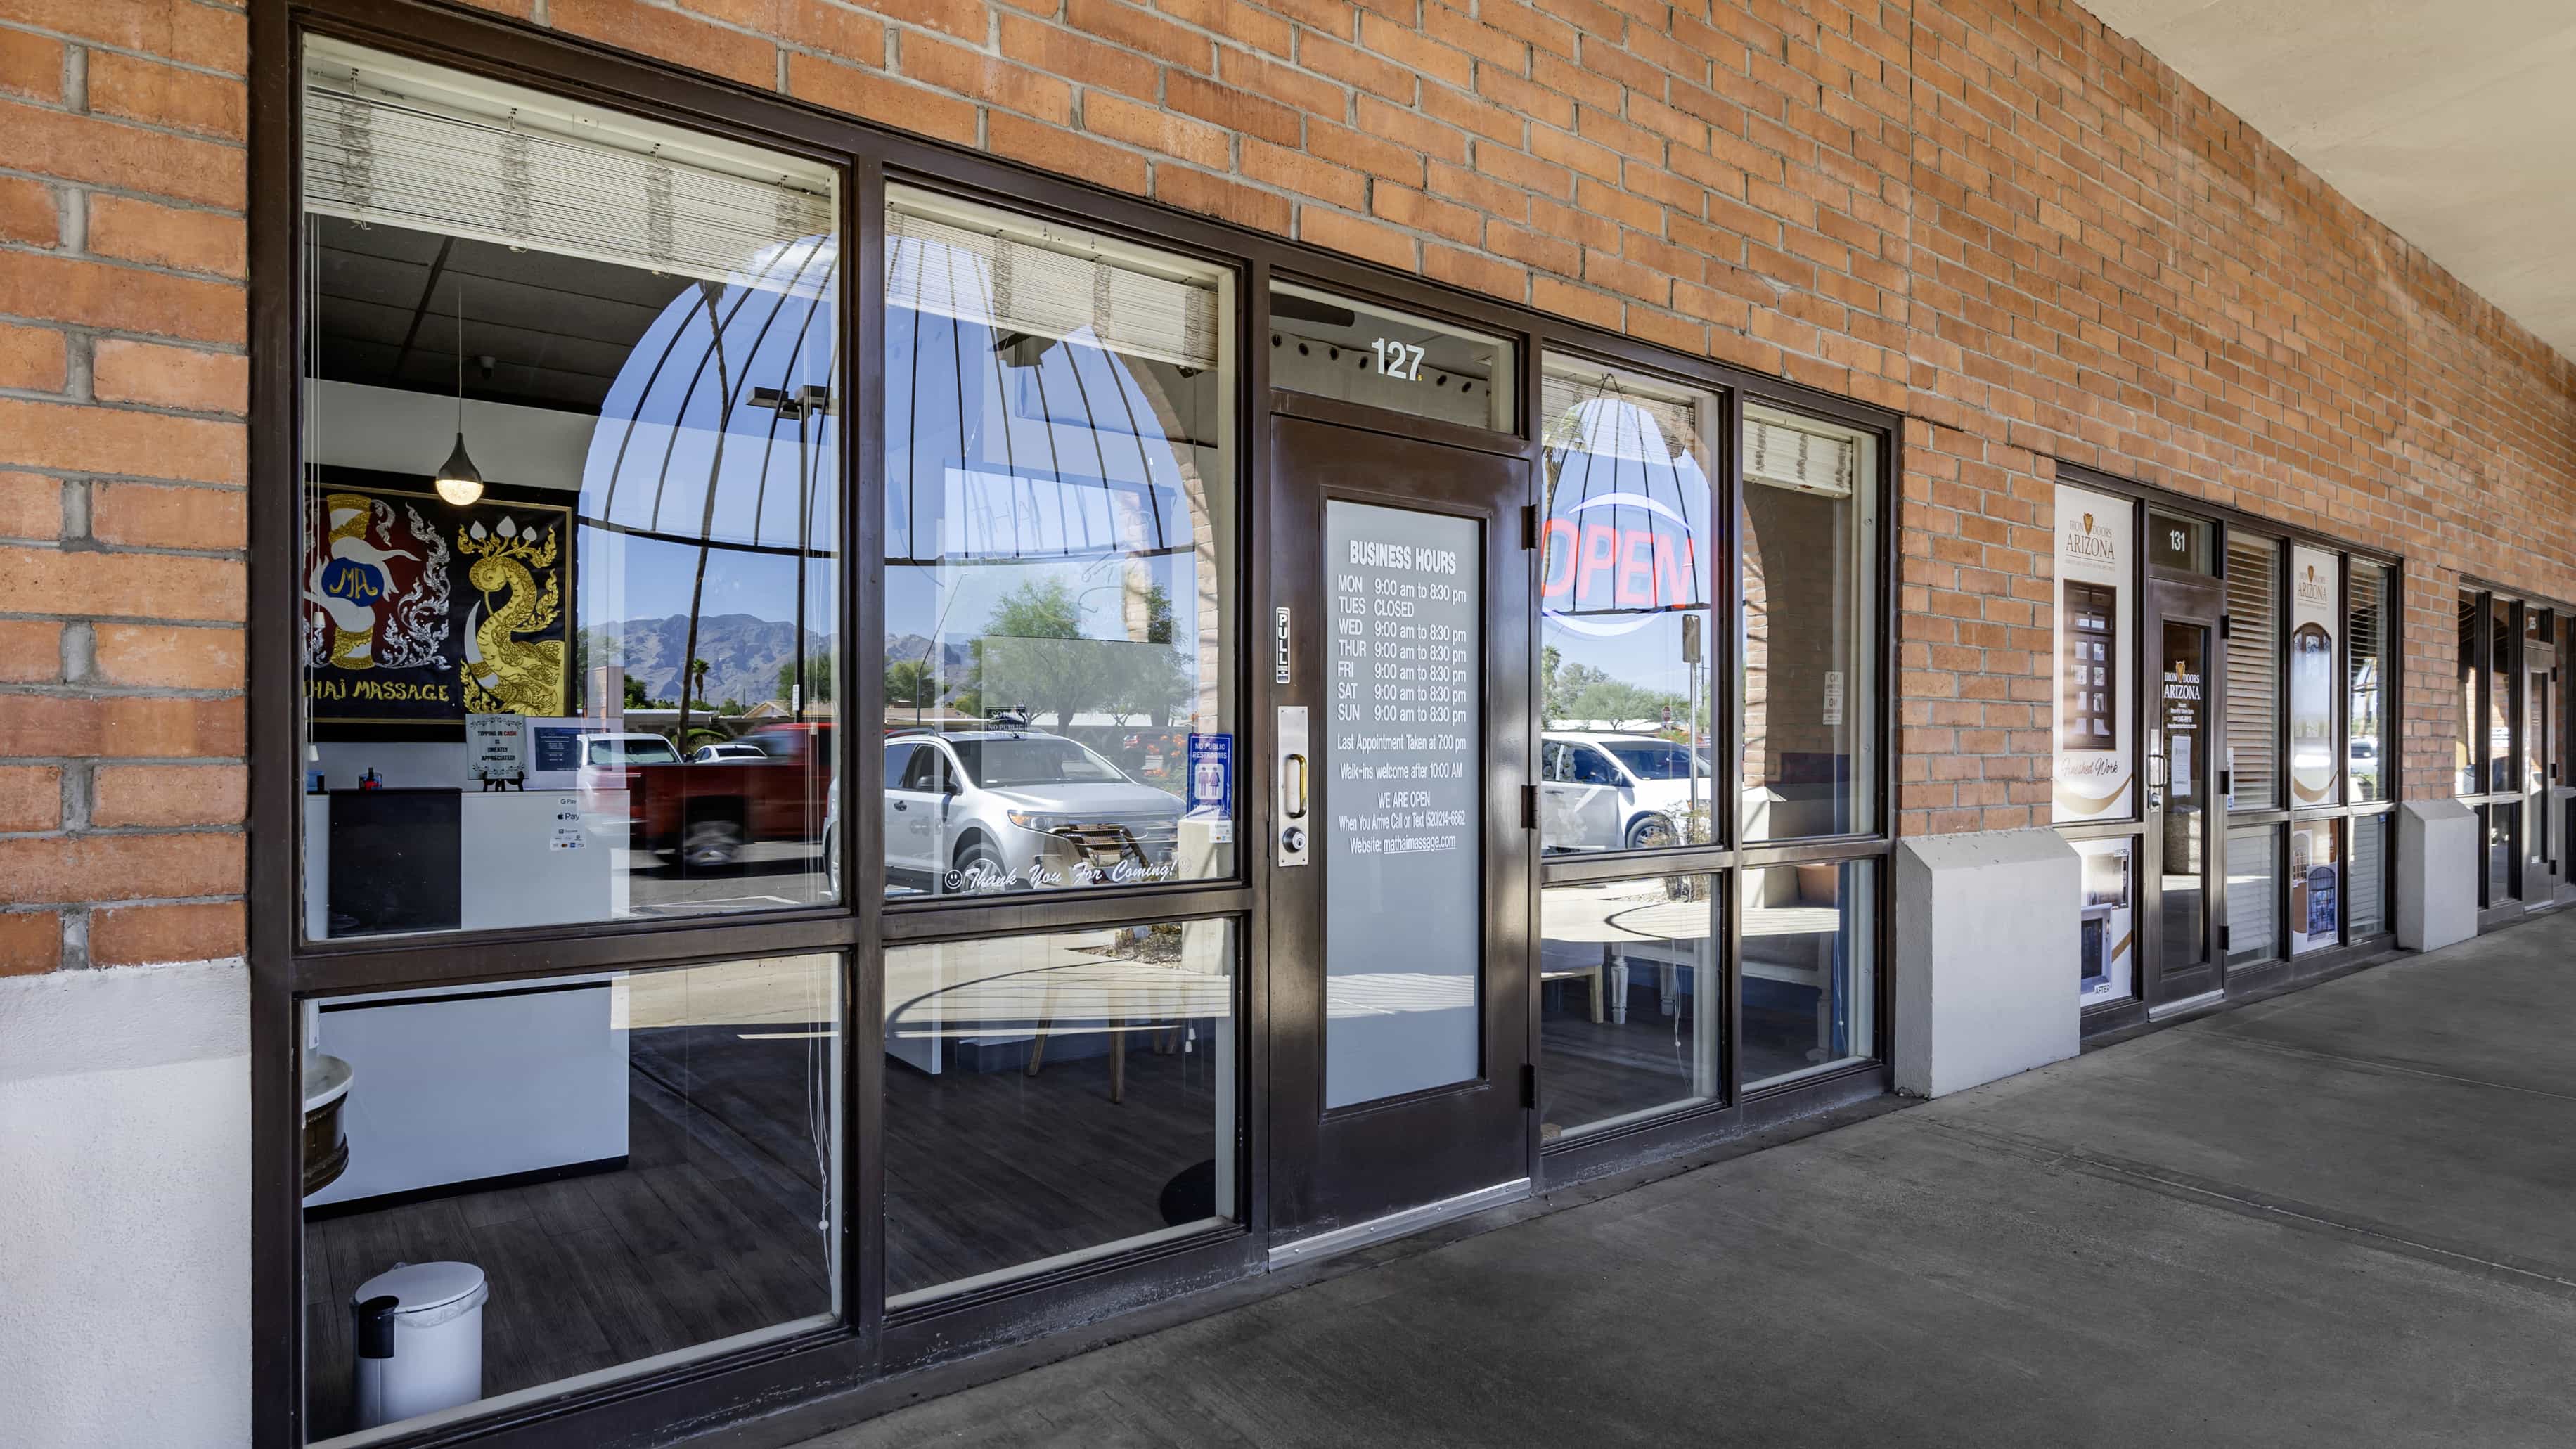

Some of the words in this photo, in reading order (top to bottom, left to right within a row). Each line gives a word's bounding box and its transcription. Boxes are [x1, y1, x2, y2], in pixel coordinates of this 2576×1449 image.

[1372, 337, 1424, 381] 127
[2092, 524, 2112, 539] DOORS
[2170, 529, 2185, 551] 131
[1350, 540, 1412, 569] BUSINESS
[1416, 548, 1457, 574] HOURS
[2066, 534, 2115, 560] ARIZONA
[1541, 518, 1694, 608] OPEN
[1338, 574, 1363, 593] MON
[1374, 578, 1397, 595] 9:00
[1400, 584, 1415, 598] am
[1417, 582, 1427, 598] to
[1430, 584, 1450, 600] 8:30
[1452, 589, 1467, 605] pm
[2298, 581, 2328, 603] ARIZONA
[1338, 596, 1366, 614] TUES
[1374, 599, 1415, 617] CLOSED
[1278, 613, 1288, 665] PULL
[1338, 618, 1363, 635] WED
[1374, 620, 1397, 637] 9:00
[1400, 626, 1415, 639] am
[1417, 624, 1427, 639] to
[1430, 624, 1450, 640] 8:30
[1452, 629, 1467, 645] pm
[1338, 639, 1367, 657] THUR
[1374, 641, 1397, 658] 9:00
[1400, 647, 1415, 659] am
[1417, 644, 1427, 659] to
[1430, 645, 1450, 661] 8:30
[1452, 650, 1467, 665] pm
[1337, 661, 1354, 678] FRI
[1374, 662, 1397, 679] 9:00
[1400, 667, 1415, 680] am
[1417, 664, 1427, 681] to
[1430, 665, 1450, 681] 8:30
[1452, 670, 1467, 686] pm
[2164, 671, 2177, 682] IRON
[2182, 674, 2200, 683] DOORS
[352, 680, 450, 702] MASSAGE
[1337, 682, 1358, 699] SAT
[1374, 683, 1397, 700] 9:00
[1400, 688, 1415, 701] am
[1417, 685, 1427, 701] to
[1430, 686, 1450, 702] 8:30
[1452, 690, 1467, 706] pm
[2164, 684, 2201, 700] ARIZONA
[1337, 703, 1360, 721] SUN
[1374, 704, 1397, 721] 9:00
[1399, 709, 1415, 721] am
[1417, 705, 1427, 721] to
[1430, 706, 1450, 722] 8:30
[1452, 710, 1467, 726] pm
[1204, 742, 1226, 750] PUBLIC
[1337, 733, 1354, 750] Last
[1356, 733, 1404, 754] Appointment
[1406, 734, 1427, 750] Taken
[1429, 734, 1436, 750] at
[1438, 734, 1453, 750] 7:00
[1455, 738, 1467, 754] pm
[1340, 763, 1373, 780] Walk-ins
[1376, 762, 1409, 779] welcome
[1410, 763, 1428, 778] after
[1429, 762, 1450, 778] 10:00
[1450, 762, 1464, 778] AM
[2094, 757, 2118, 776] Work
[1377, 792, 1391, 809] WE
[1393, 792, 1408, 808] ARE
[1410, 791, 1431, 807] OPEN
[565, 813, 579, 821] Pay
[1339, 815, 1358, 832] When
[1358, 814, 1370, 831] You
[1372, 813, 1389, 830] Arrive
[1391, 812, 1403, 829] Call
[1403, 816, 1410, 829] or
[1412, 811, 1424, 827] Text
[1349, 837, 1382, 854] Website:
[1383, 835, 1457, 854] mathaimassage.com
[965, 867, 1017, 889] Thank
[1029, 864, 1062, 889] You
[1072, 861, 1103, 884] For
[1112, 859, 1178, 882] Coming!
[2095, 984, 2110, 994] AFTER
